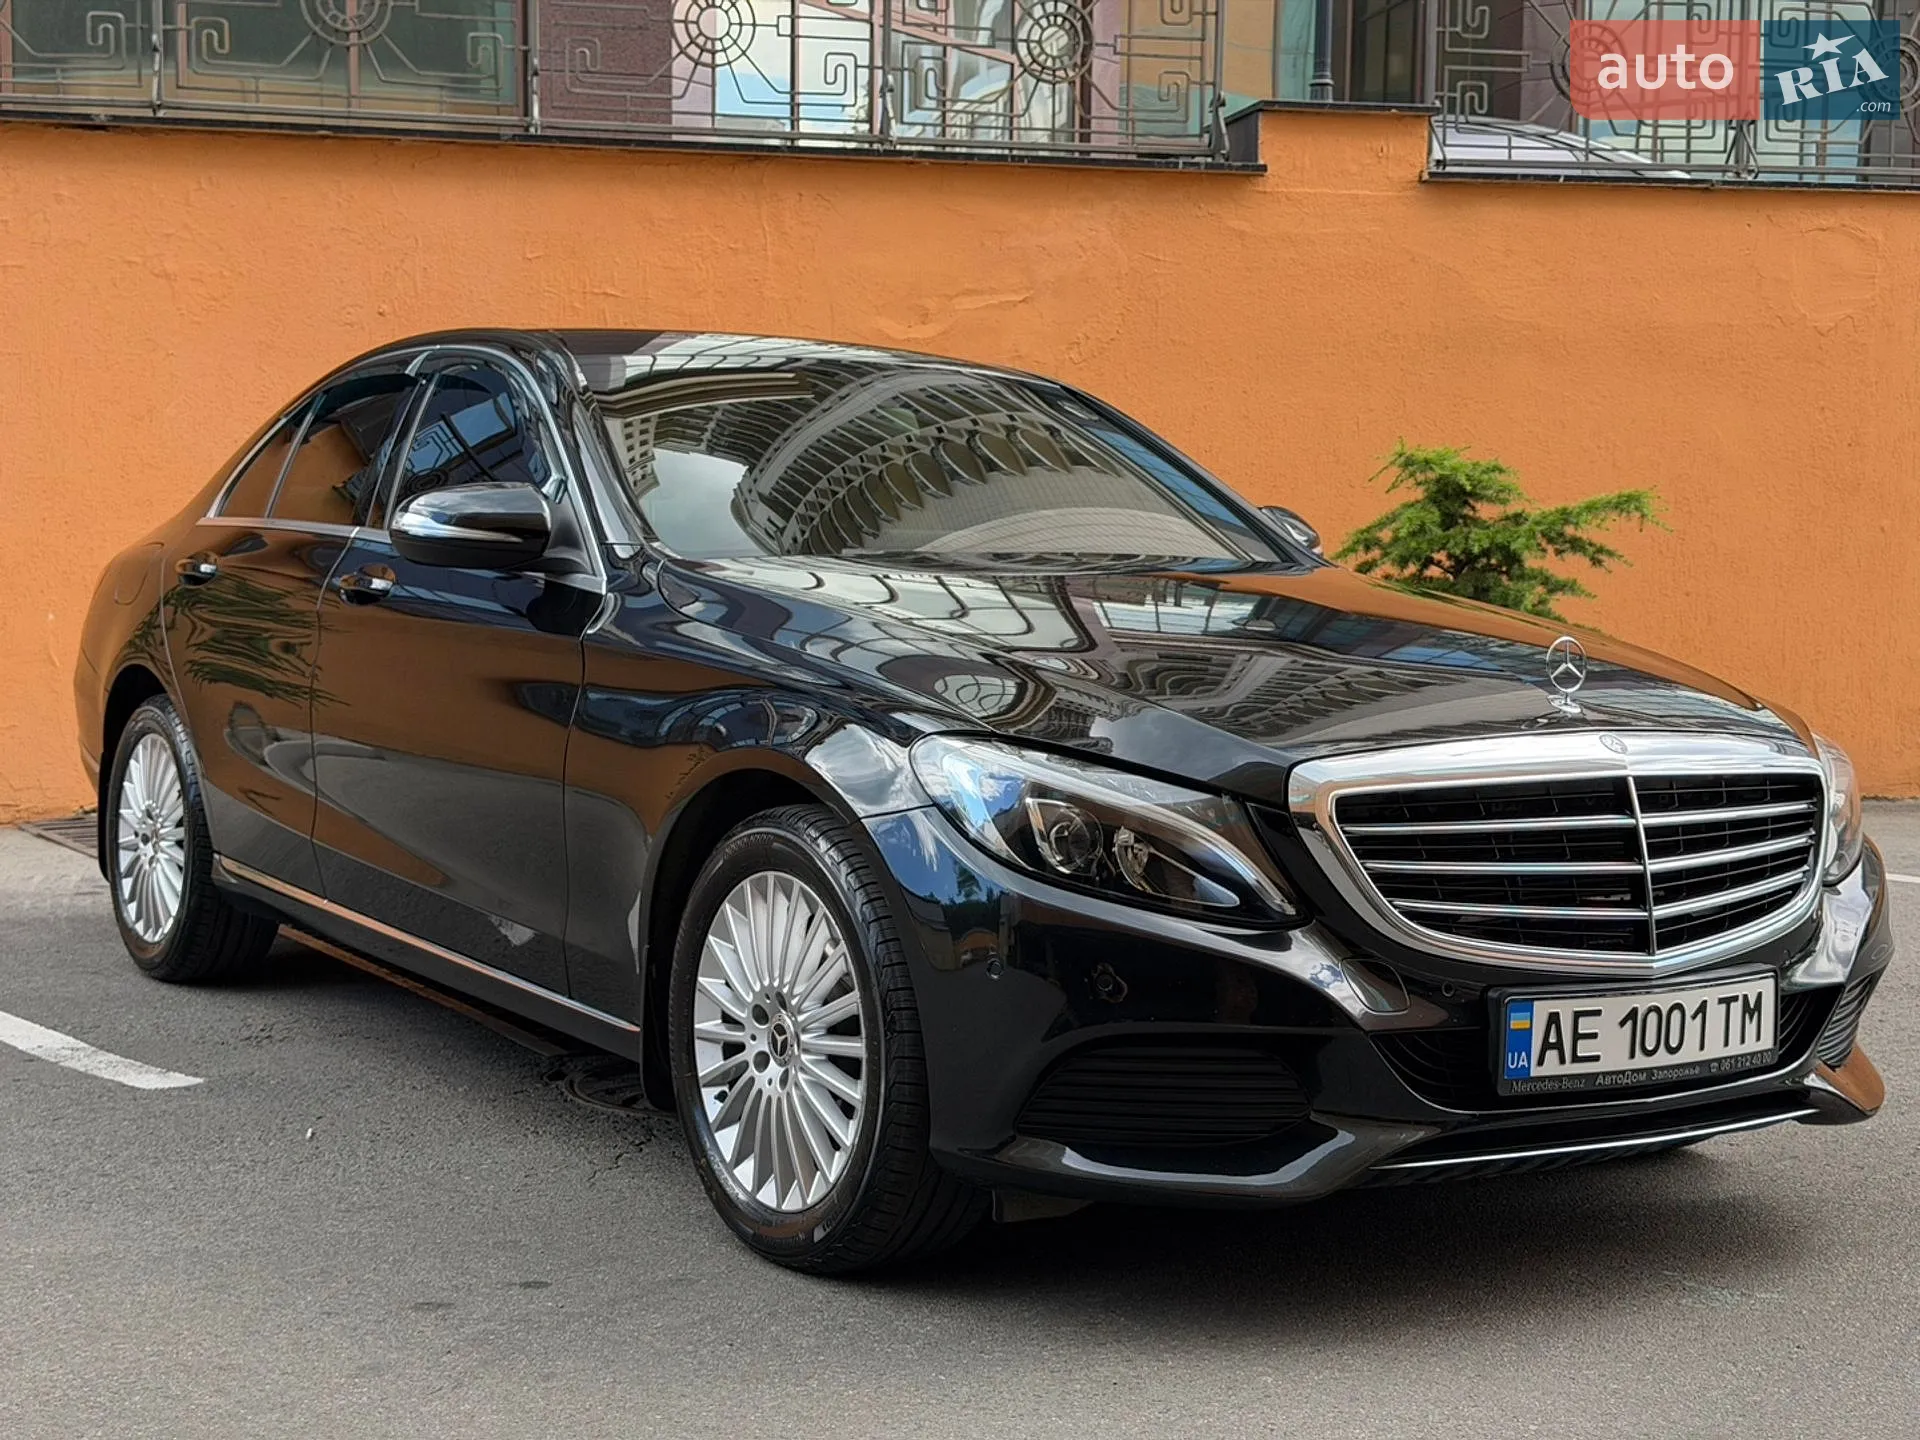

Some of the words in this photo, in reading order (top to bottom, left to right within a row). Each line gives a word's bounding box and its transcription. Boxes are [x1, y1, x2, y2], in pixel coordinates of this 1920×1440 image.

[1537, 1009, 1602, 1067] AE
[1618, 999, 1709, 1060] 1001
[1717, 990, 1763, 1048] TM
[1507, 1051, 1528, 1069] UA
[1511, 1077, 1586, 1094] Mercedes-Benz
[1595, 1070, 1647, 1087] АвтоДом
